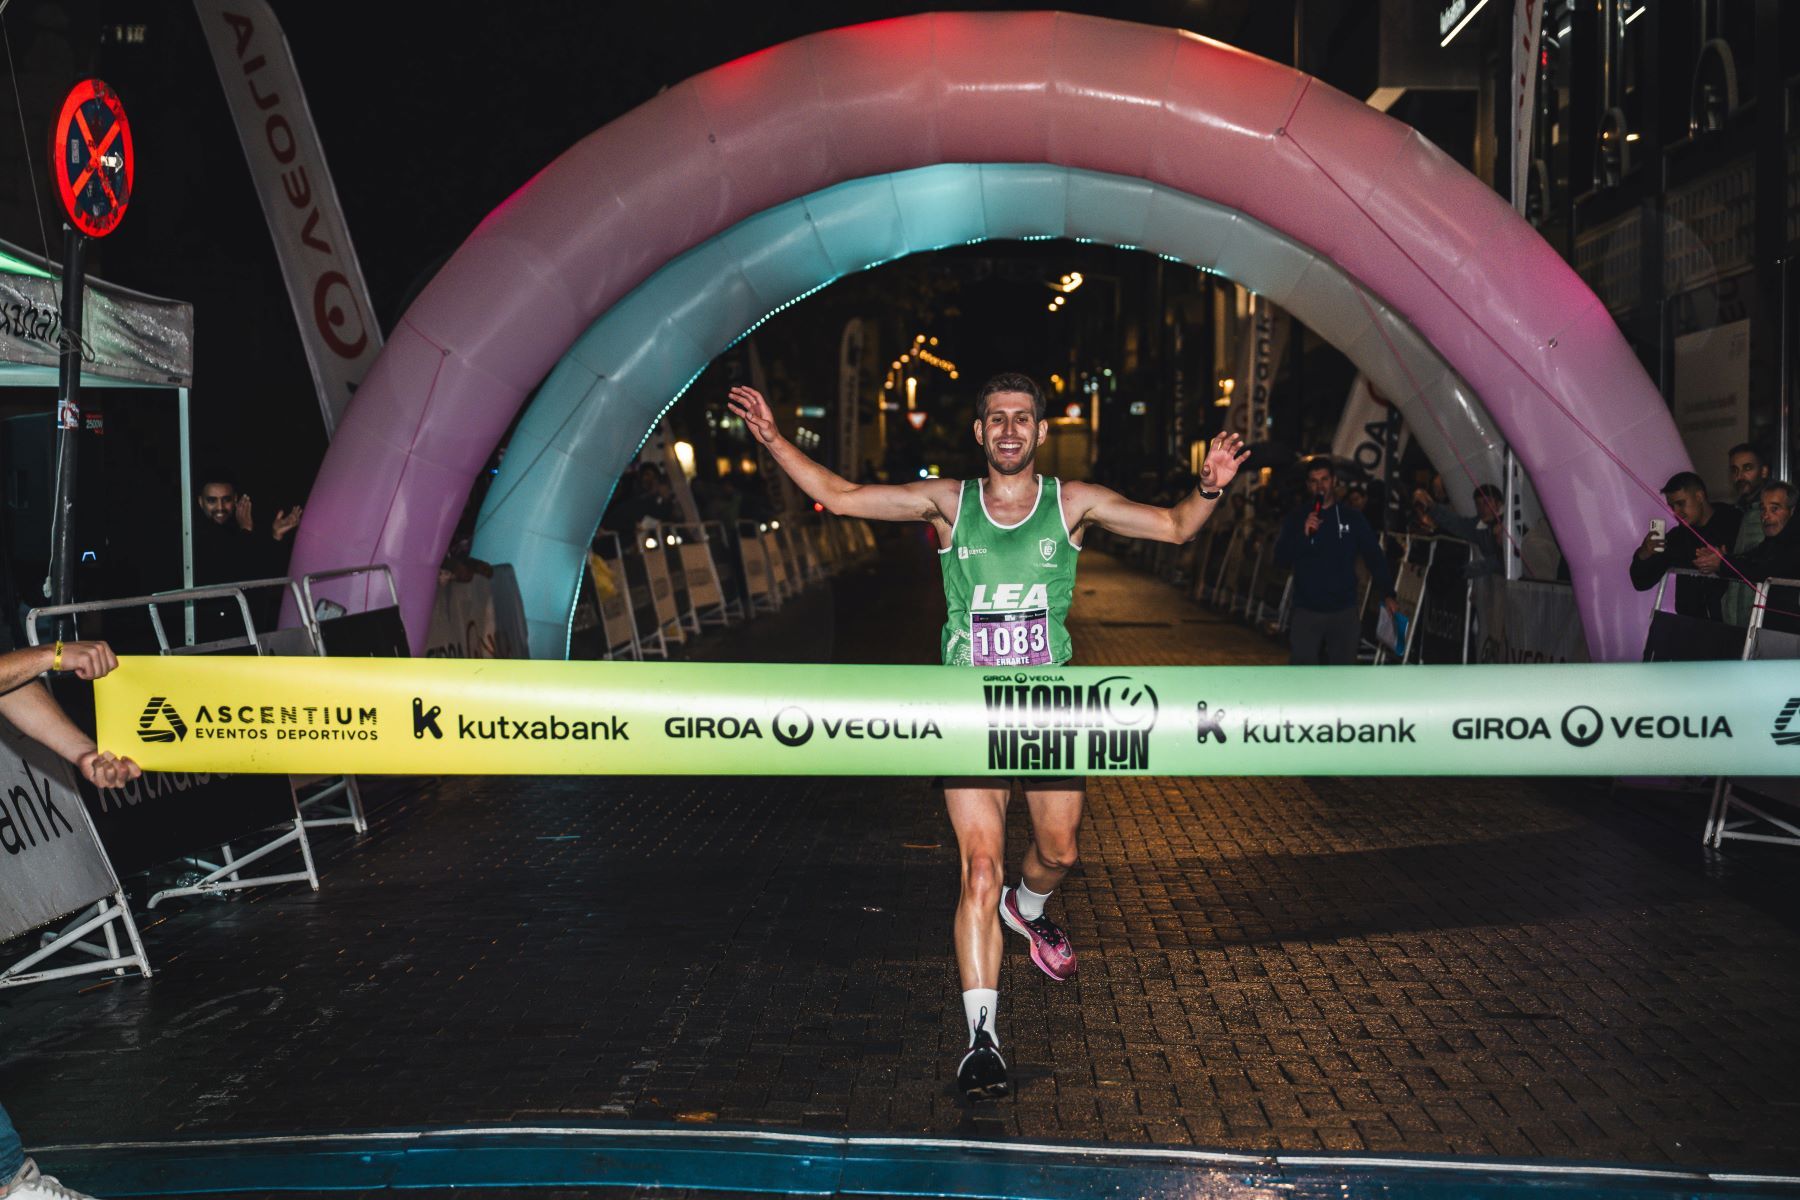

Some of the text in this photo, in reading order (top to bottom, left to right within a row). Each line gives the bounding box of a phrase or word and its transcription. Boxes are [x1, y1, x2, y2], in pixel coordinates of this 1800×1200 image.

[971, 584, 1048, 610] LEA
[976, 624, 1045, 656] 1083
[996, 657, 1030, 666] ERRARTE
[195, 705, 378, 725] ASCENTIUM
[983, 685, 1104, 728] VITORIA
[195, 728, 378, 740] EVENTOS DEPORTIVOS
[458, 713, 630, 741] kutxabank
[664, 717, 943, 740] GIROA VEOLIA
[1243, 717, 1417, 743] kutxabank
[1452, 715, 1733, 740] GIROA VEOLIA
[988, 730, 1149, 770] NIGHT RUN
